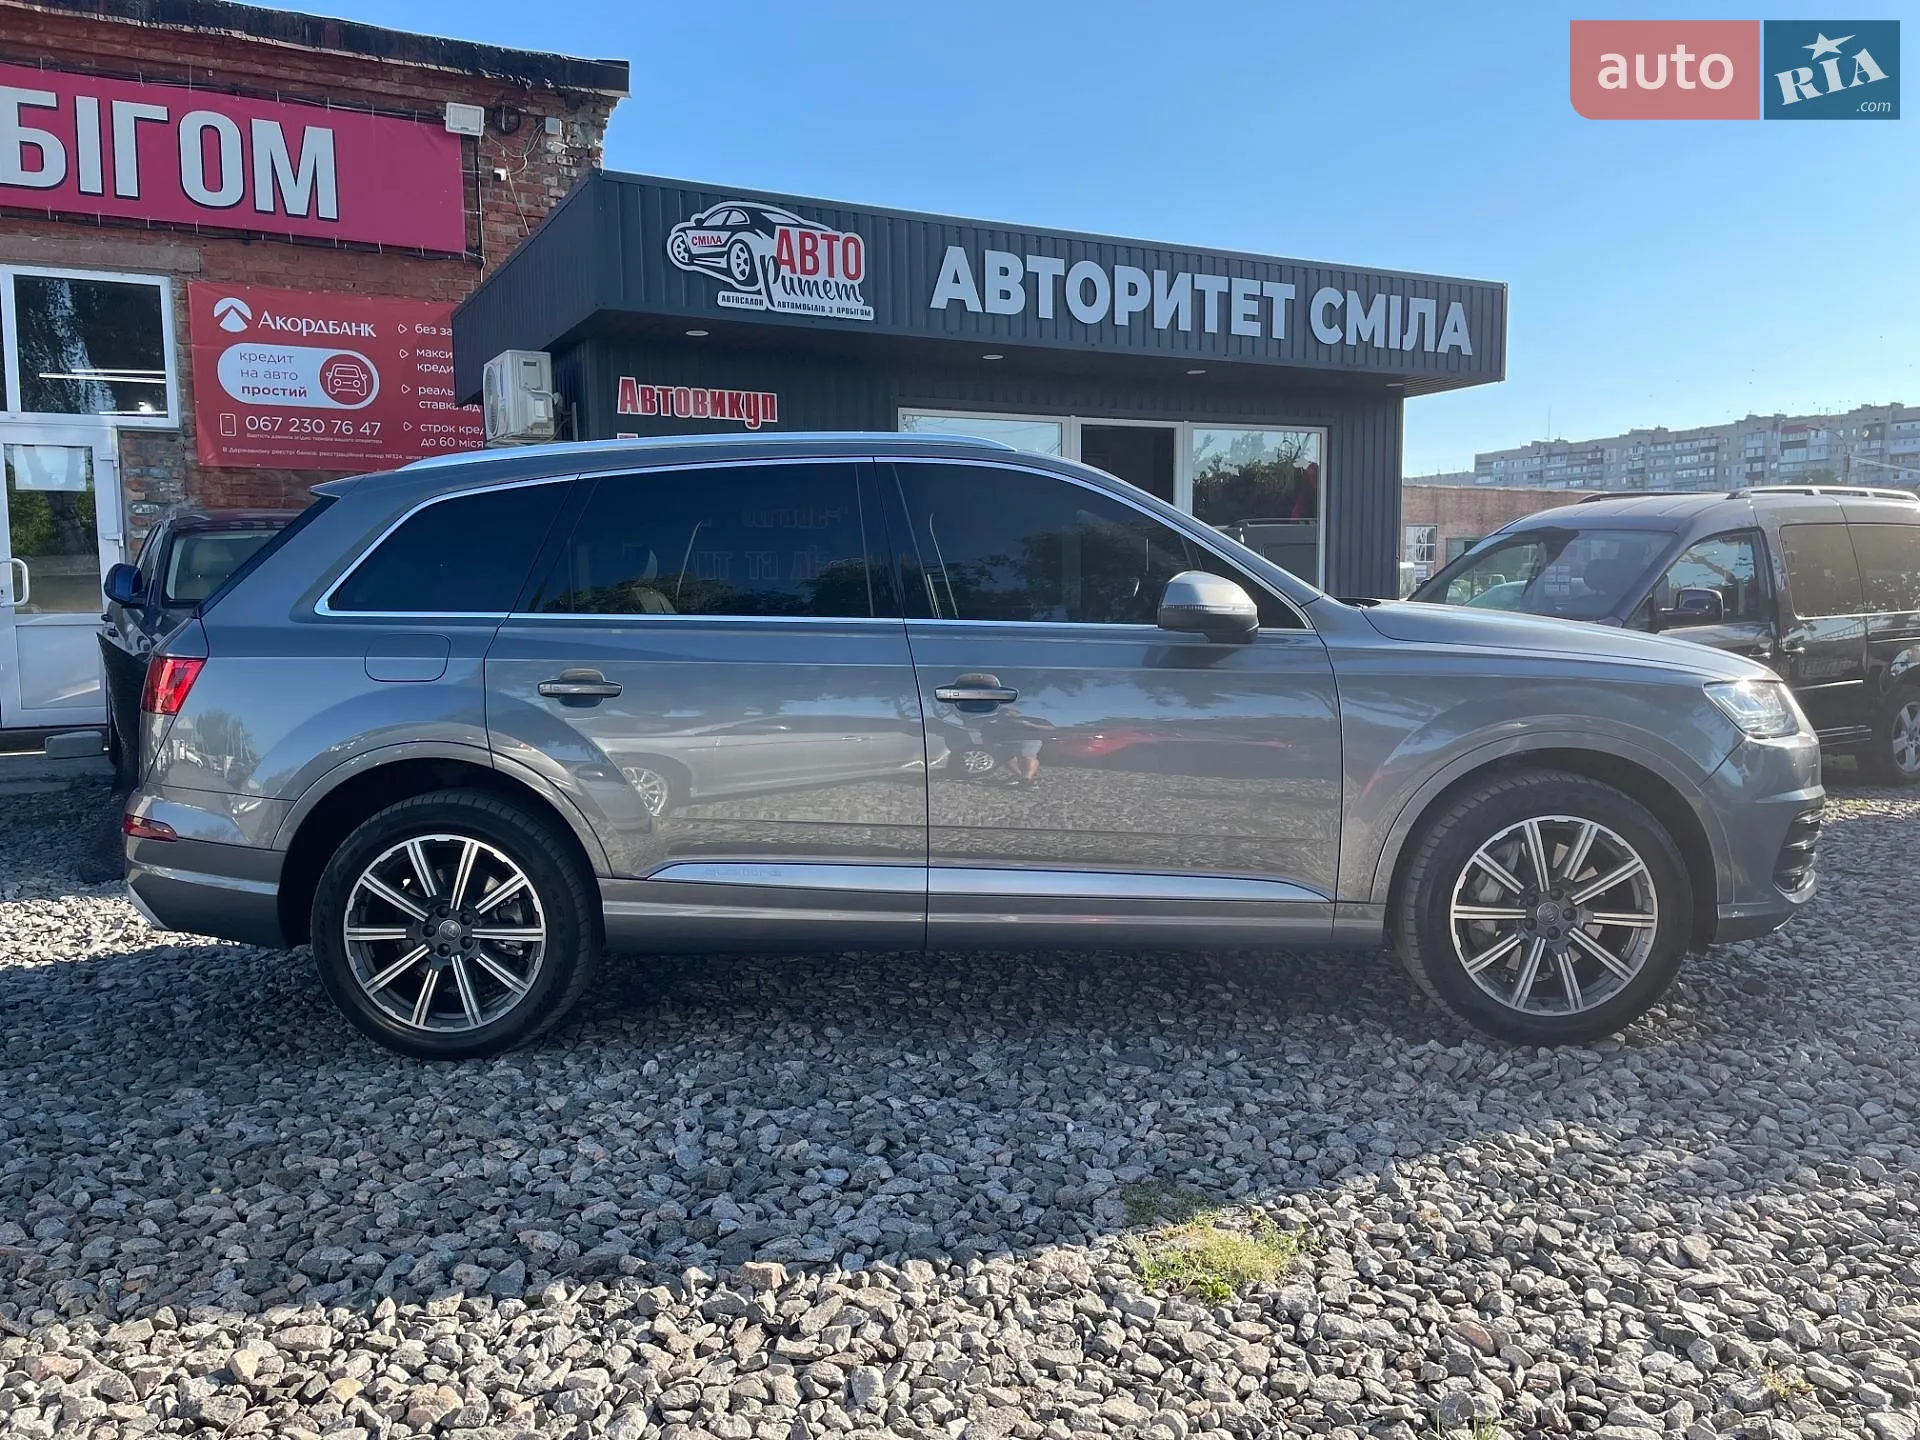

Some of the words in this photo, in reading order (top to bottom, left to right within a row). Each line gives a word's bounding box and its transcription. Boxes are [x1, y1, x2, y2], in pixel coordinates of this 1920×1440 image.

[691, 234, 723, 247] СМІЛА
[776, 228, 861, 281] АВТО
[721, 294, 764, 307] АВТОСАЛОН
[777, 301, 826, 313] АВТОМОБІЛІВ
[836, 306, 872, 317] ПРОБІГОМ
[929, 245, 1295, 340] АВТОРИТЕТ
[1309, 286, 1473, 356] СМІЛА
[415, 324, 437, 335] без
[239, 352, 295, 365] кредит
[240, 368, 258, 378] на
[263, 370, 298, 381] авто
[241, 385, 307, 398] простий
[245, 415, 282, 431] 067
[289, 417, 325, 434] 230
[330, 420, 353, 435] 76
[359, 422, 381, 436] 47
[420, 423, 456, 435] строк
[420, 437, 436, 448] до
[439, 436, 456, 447] 60
